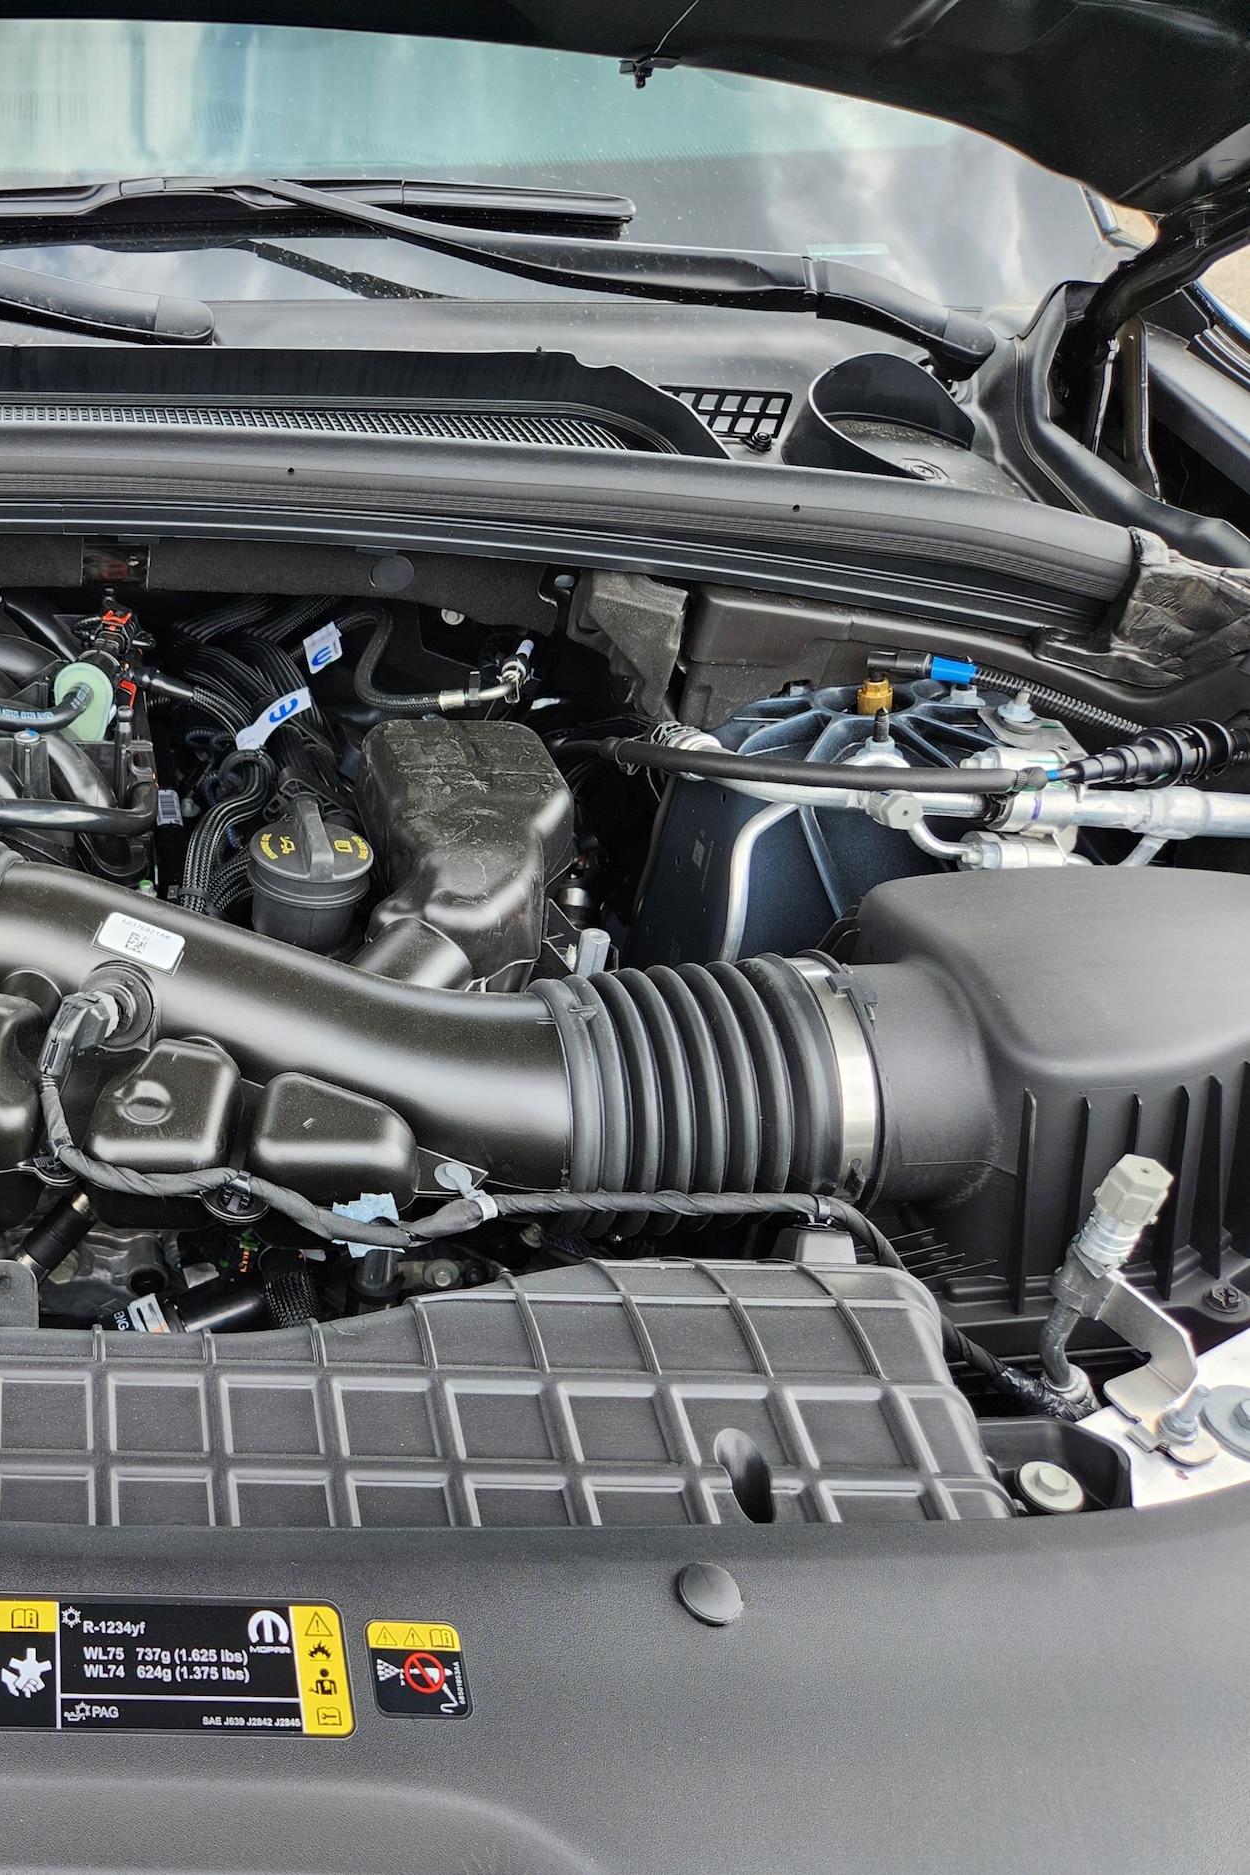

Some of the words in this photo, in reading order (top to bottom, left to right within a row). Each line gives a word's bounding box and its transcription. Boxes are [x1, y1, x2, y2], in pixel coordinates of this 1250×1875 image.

[82, 1620, 146, 1637] R-1234yf
[83, 1646, 125, 1660] WL75
[135, 1647, 171, 1664] 737g
[174, 1648, 218, 1664] (1.625
[220, 1649, 248, 1666] lbs)
[83, 1664, 125, 1678] WL74
[136, 1665, 172, 1682] 624g
[175, 1665, 219, 1682] (1.375
[221, 1666, 250, 1684] lbs)
[91, 1705, 119, 1718] PAG
[202, 1716, 222, 1726] SAE
[224, 1717, 245, 1726] J639
[246, 1717, 273, 1727] J2842
[274, 1718, 301, 1727] J2845
